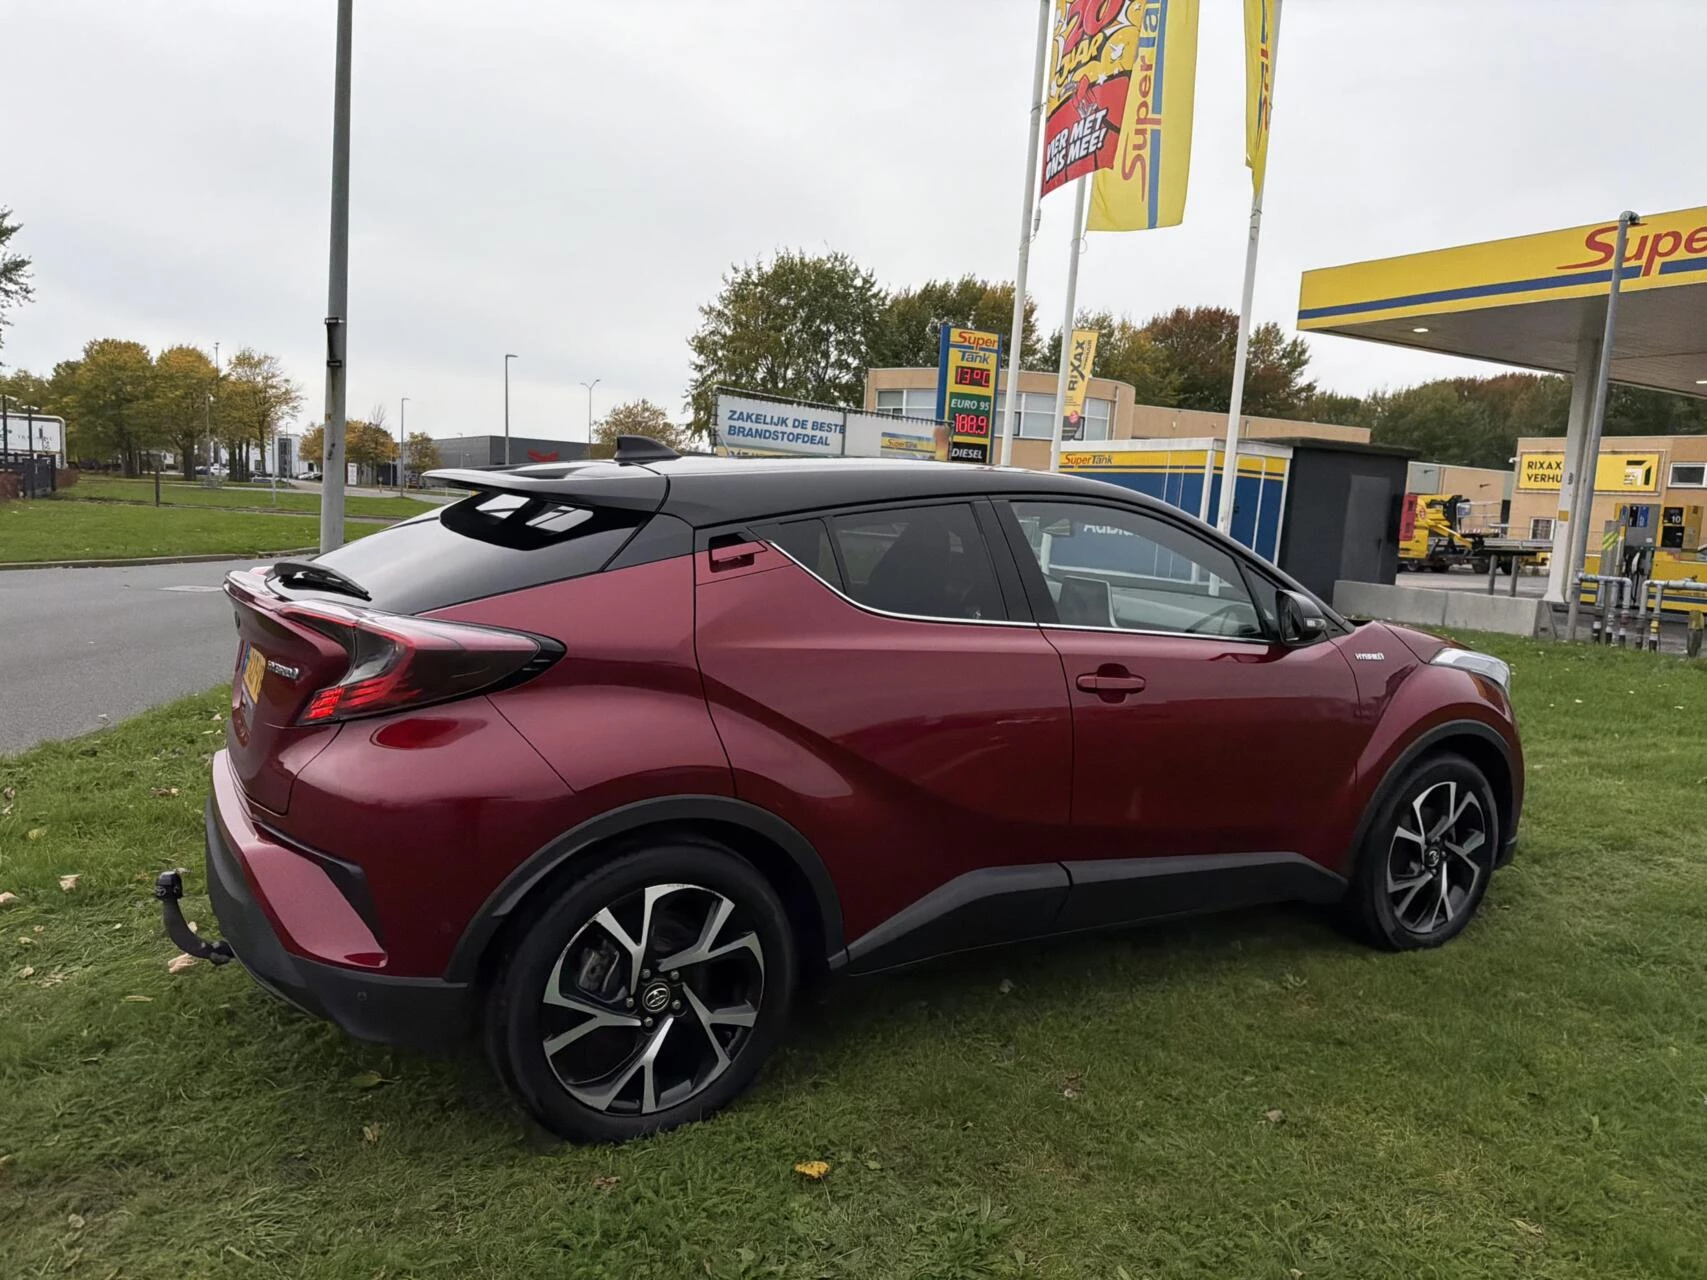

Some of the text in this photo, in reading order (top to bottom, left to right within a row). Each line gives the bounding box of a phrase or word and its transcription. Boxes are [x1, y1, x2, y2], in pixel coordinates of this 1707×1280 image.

[1070, 108, 1107, 143] MET
[1046, 128, 1107, 182] ONS MEE!
[952, 331, 997, 350] Super
[958, 350, 990, 364] Tank
[1068, 339, 1085, 391] RIXAX
[951, 399, 990, 410] EURO 95
[727, 410, 845, 434] ZAKELIJK DE BESTE
[727, 425, 830, 447] BRANDSTOFDEAL
[952, 448, 982, 459] DIESEL
[1527, 460, 1562, 470] RIXAX
